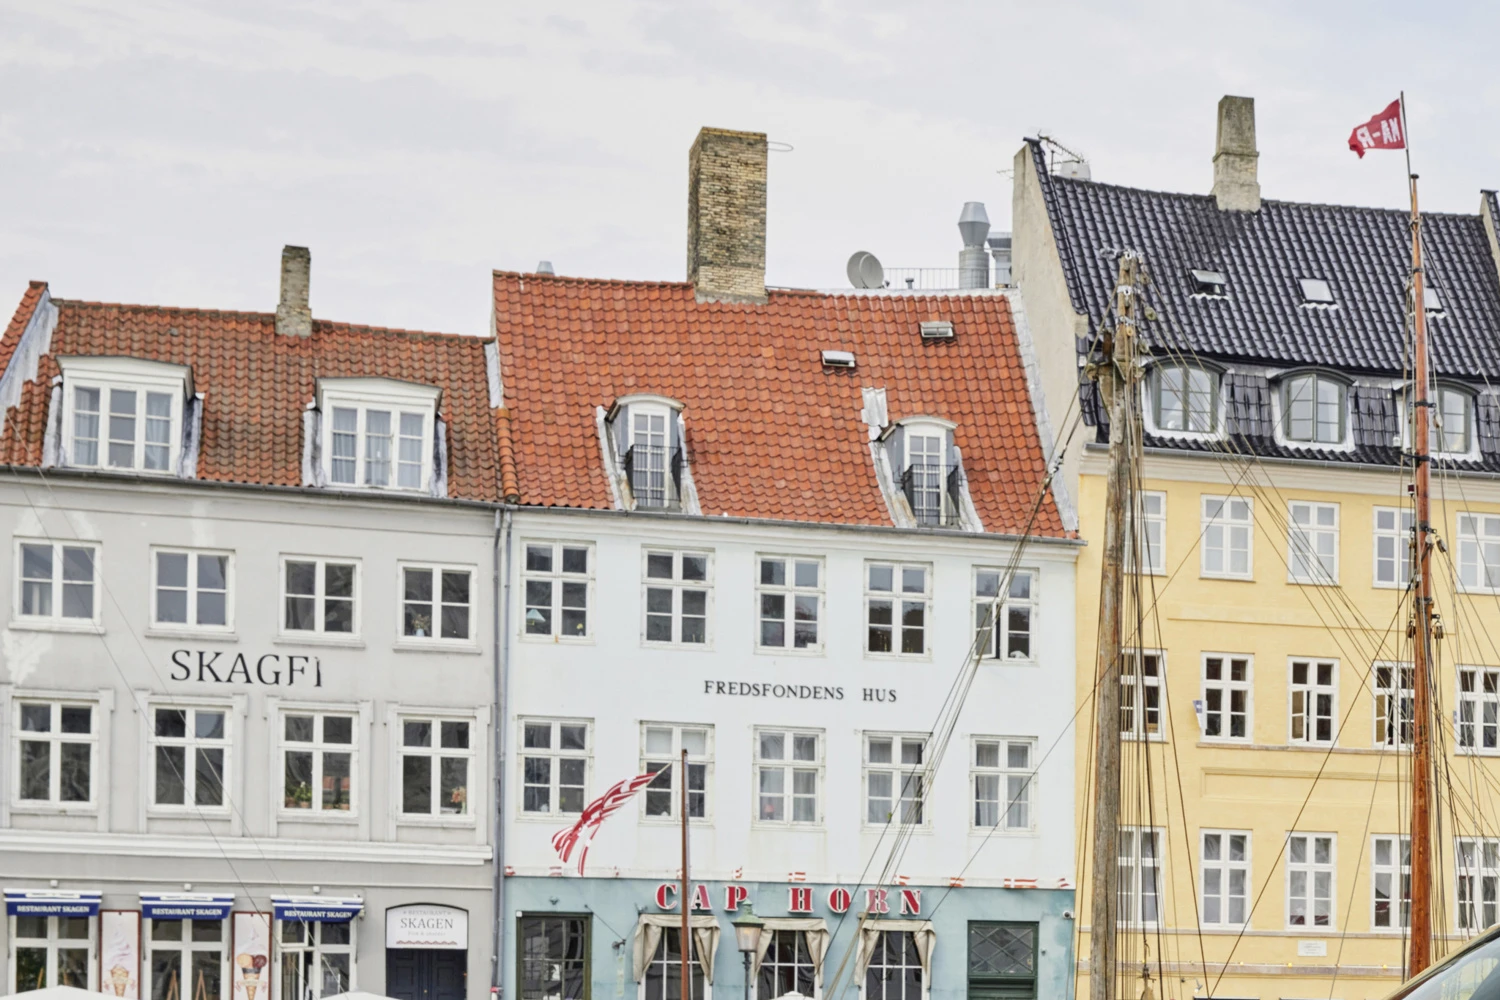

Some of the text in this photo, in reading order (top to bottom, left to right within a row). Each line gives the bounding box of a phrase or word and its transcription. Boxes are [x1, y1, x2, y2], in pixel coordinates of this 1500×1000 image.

[703, 680, 897, 702] FREDSFONDENS HUS
[655, 883, 921, 915] CAP HORN
[62, 905, 90, 913] SKAGEN
[152, 907, 222, 916] RESTAURANT SKAGEN
[284, 910, 353, 919] RESTAURANT SKAGEN
[400, 917, 454, 929] SKAGEN
